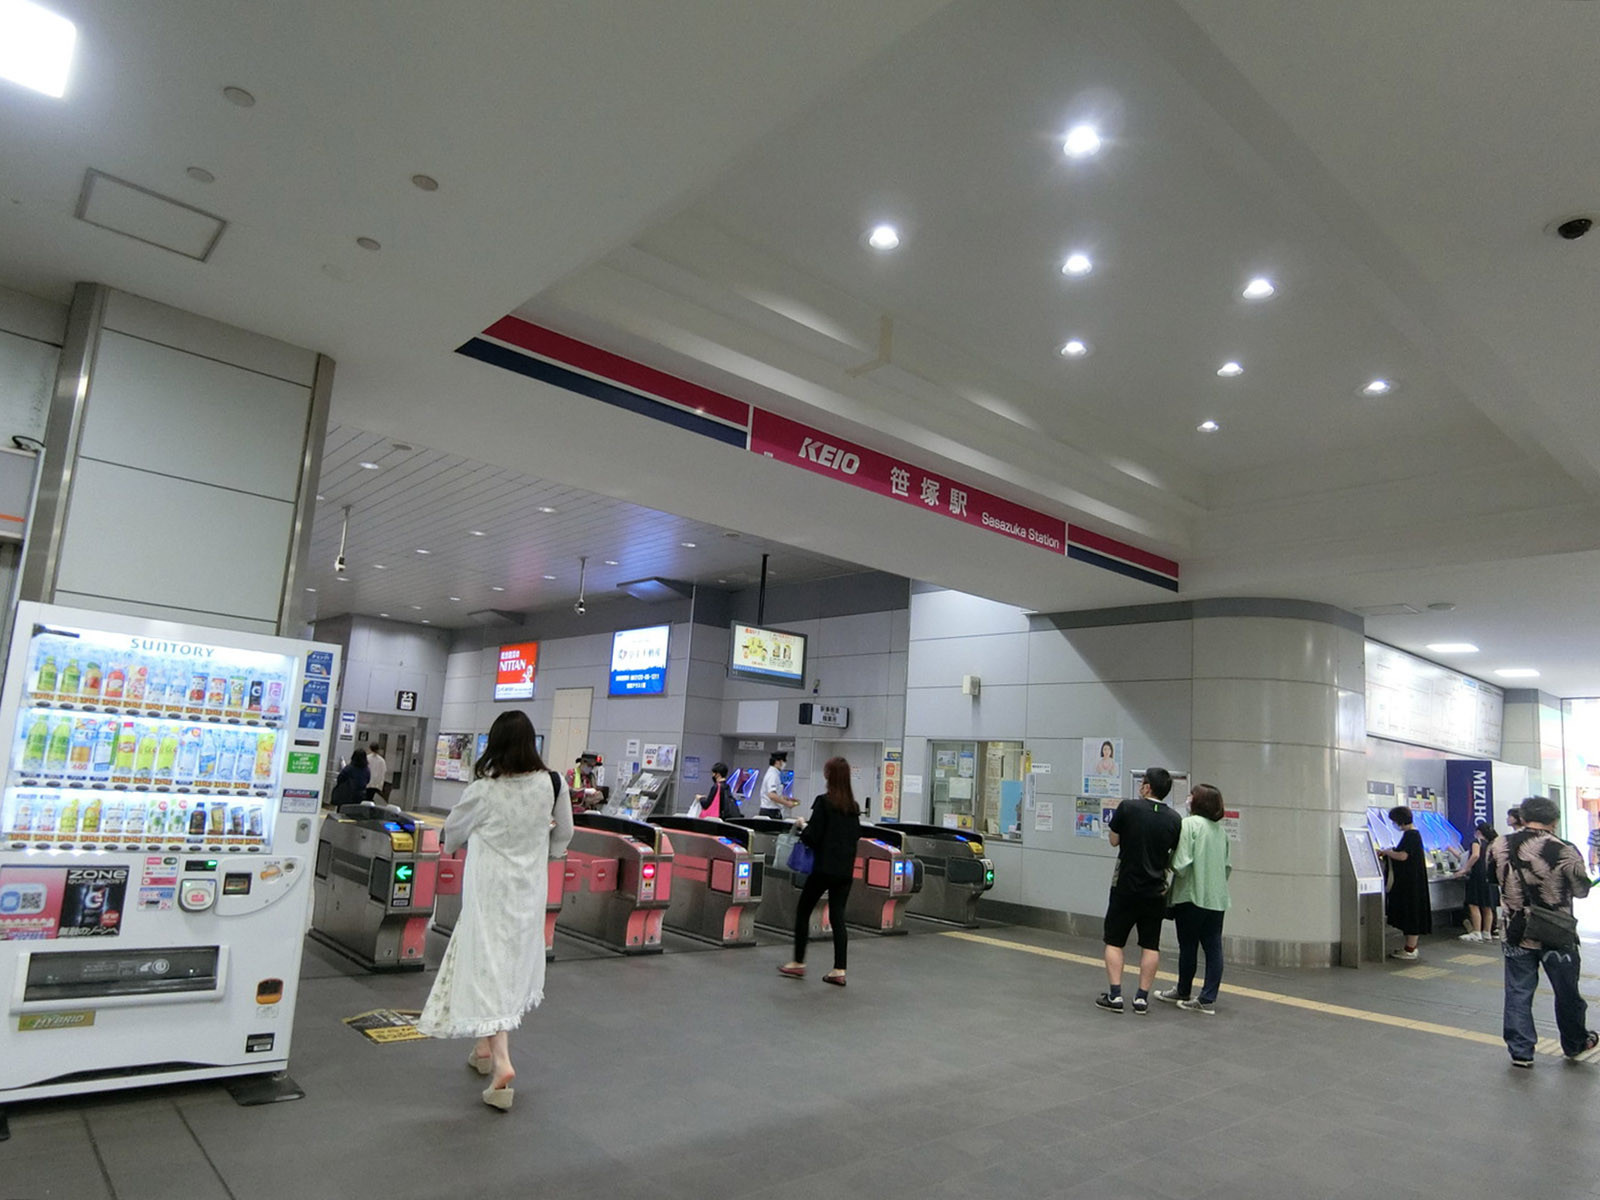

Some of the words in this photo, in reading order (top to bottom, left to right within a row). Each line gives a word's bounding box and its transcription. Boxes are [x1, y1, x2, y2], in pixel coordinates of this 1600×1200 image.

[798, 437, 860, 475] KEIO
[890, 466, 968, 517] 笹塚駅
[981, 512, 1026, 538] Sasazuka
[1028, 528, 1060, 549] Station
[130, 638, 215, 657] SUNTORY
[499, 659, 526, 671] NITTAN
[33, 1015, 85, 1028] HYBRID
